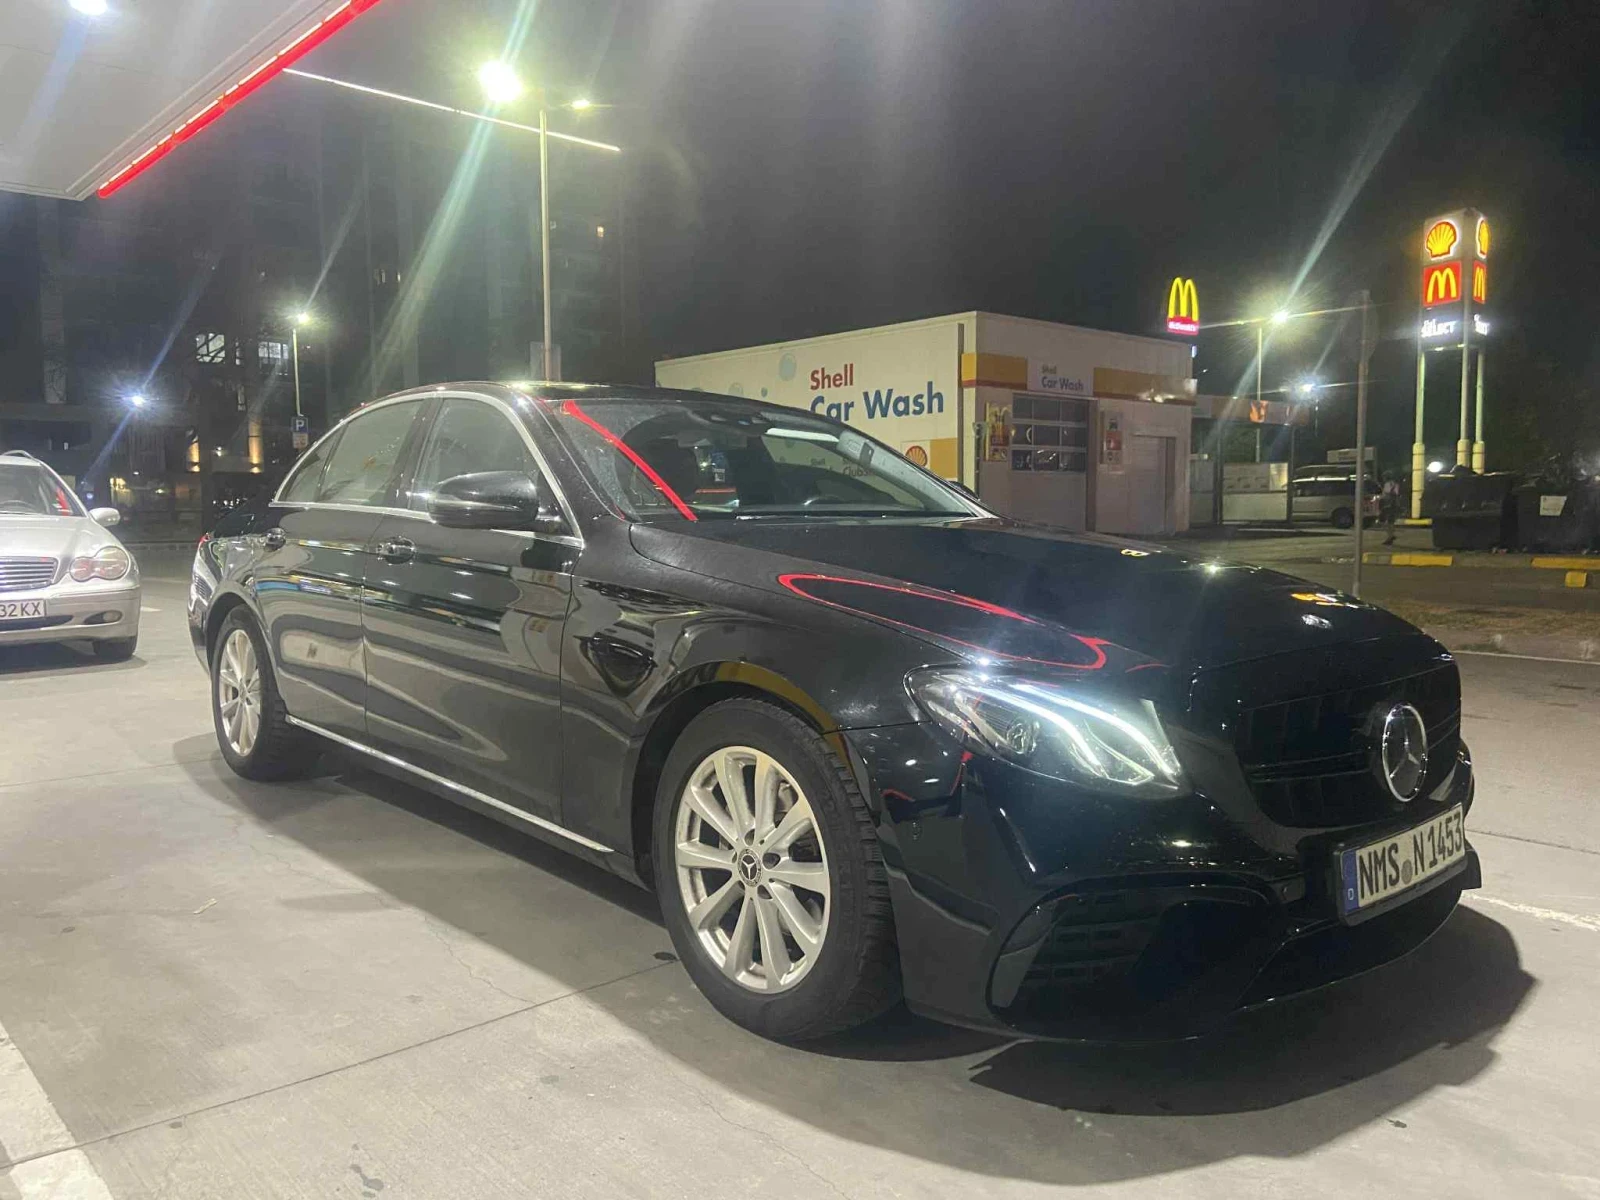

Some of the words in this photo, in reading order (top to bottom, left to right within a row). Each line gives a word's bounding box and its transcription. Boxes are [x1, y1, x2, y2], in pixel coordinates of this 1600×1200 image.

[810, 362, 854, 391] Shell
[1041, 376, 1057, 389] Car
[1059, 377, 1084, 391] Wash
[862, 380, 944, 420] Wash
[295, 419, 305, 432] P
[20, 601, 42, 616] KX
[1358, 842, 1400, 900] NMS
[1413, 831, 1425, 876] N
[1427, 812, 1463, 868] 1453
[1347, 888, 1355, 901] D
